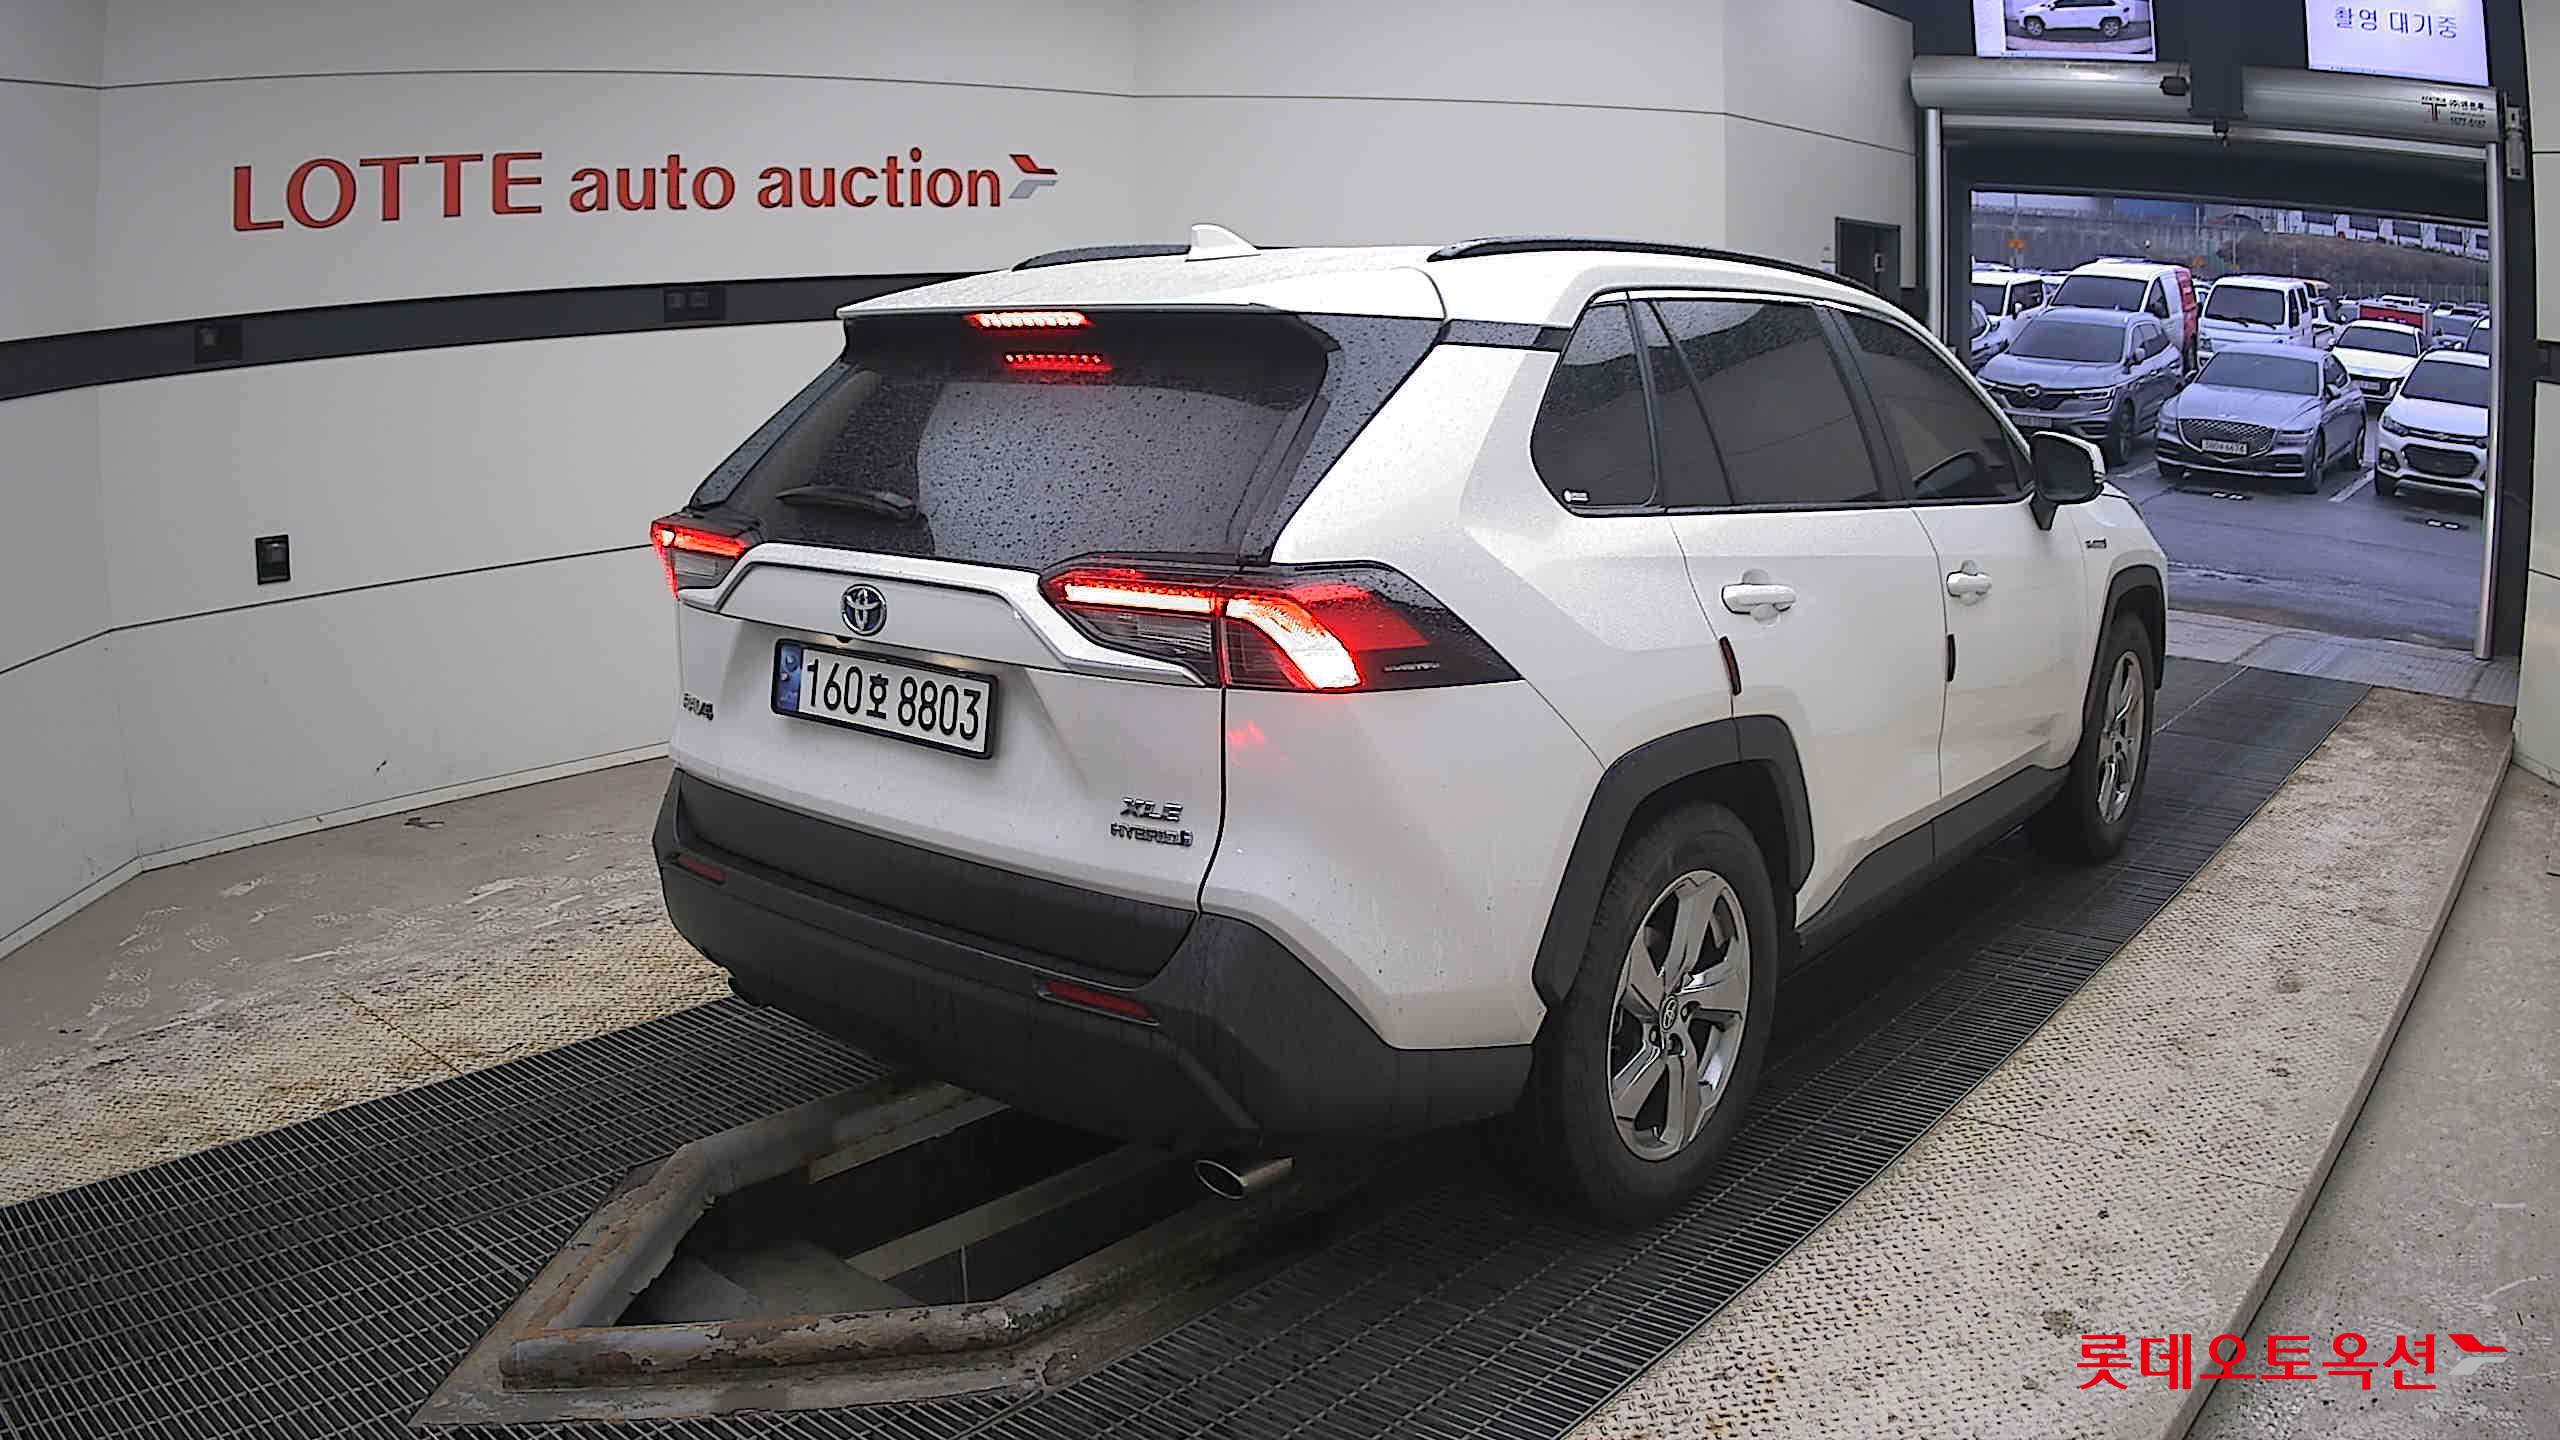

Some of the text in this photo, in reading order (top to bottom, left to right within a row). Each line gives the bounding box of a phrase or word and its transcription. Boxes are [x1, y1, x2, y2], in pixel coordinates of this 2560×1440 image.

[2335, 6, 2457, 39] 촬영 대기중
[233, 147, 1001, 231] LOTTE auto auction
[807, 658, 982, 741] 160호 8803
[1120, 797, 1183, 822] XLE
[1110, 823, 1179, 845] HYBRID
